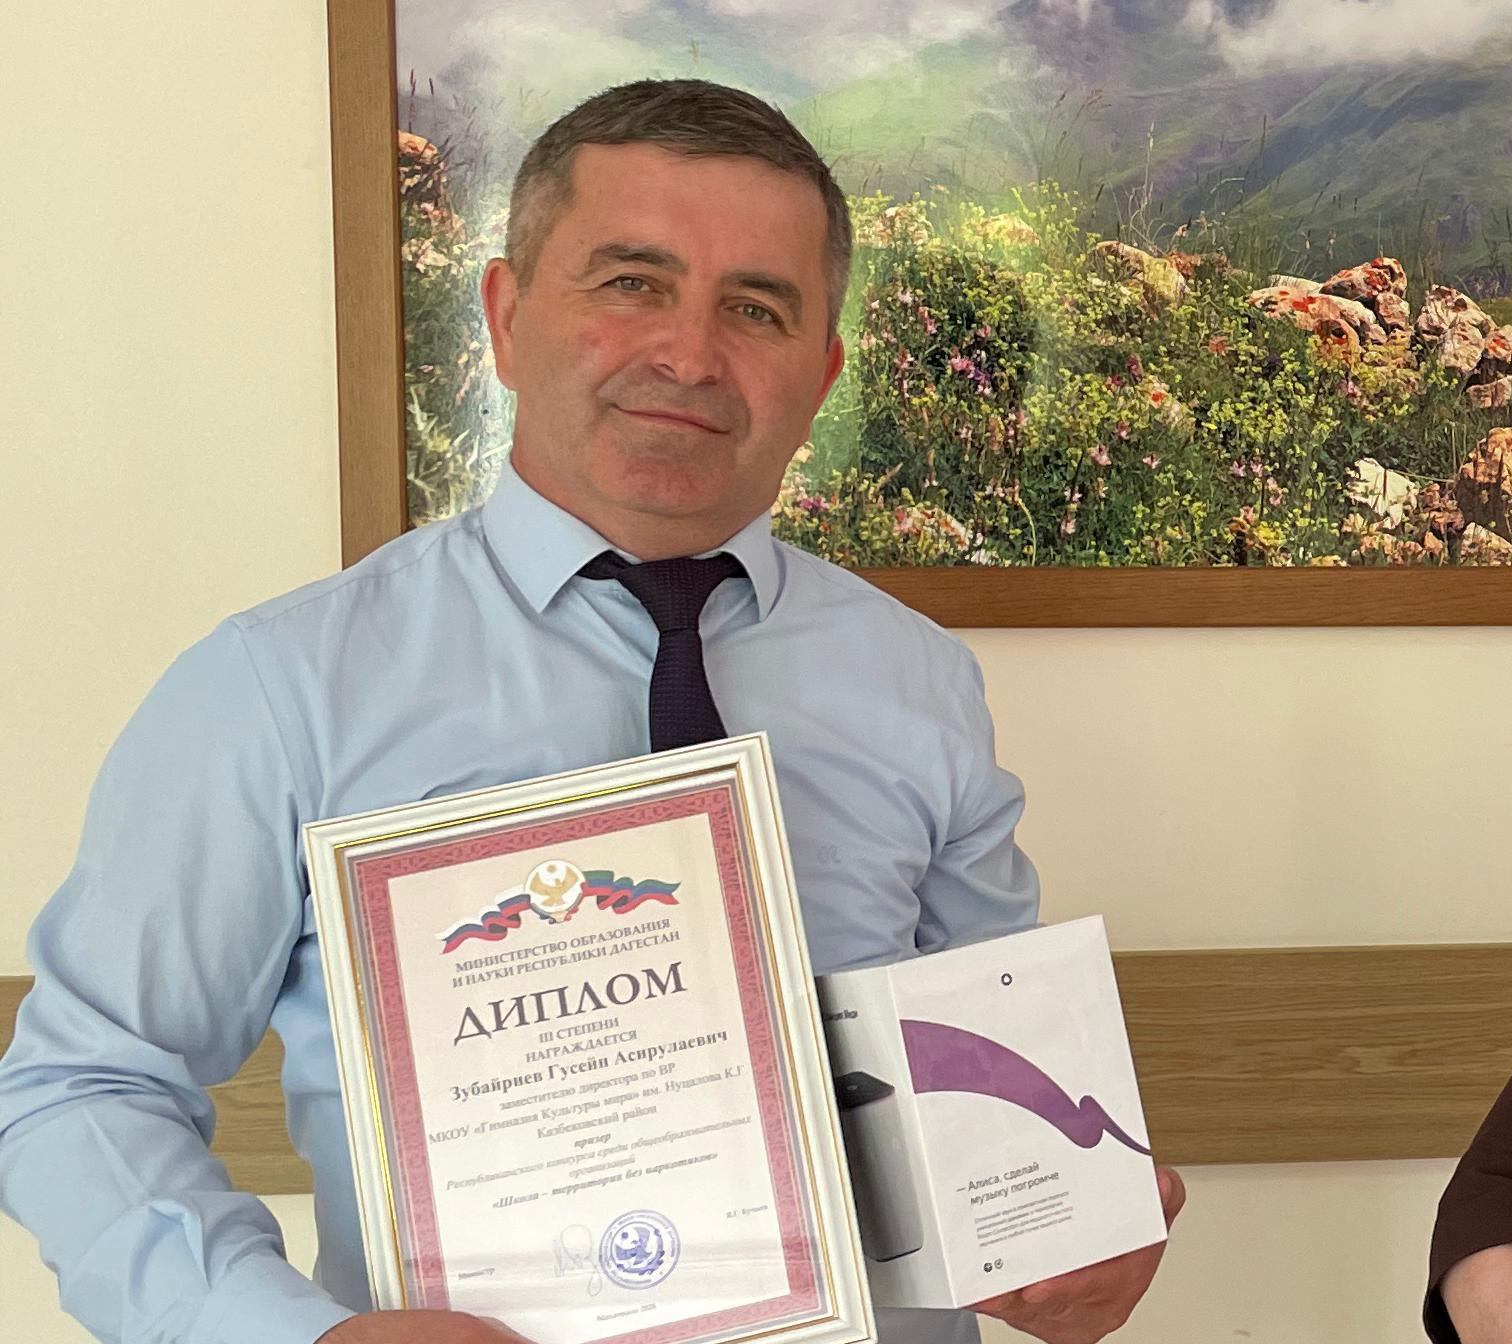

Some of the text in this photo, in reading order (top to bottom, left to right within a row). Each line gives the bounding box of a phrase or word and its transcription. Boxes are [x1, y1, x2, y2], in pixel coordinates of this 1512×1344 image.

[452, 930, 681, 989] И НАУКИ РЕСПУБЛИКИ ДАГЕСТАН
[455, 918, 671, 973] МИНИСТЕРСТВО ОБРАЗОВАНИЯ
[453, 961, 688, 1047] ДИПЛОМ
[525, 1029, 638, 1063] НАГРАЖДАЕТСЯ
[556, 1017, 620, 1040] СТЕПЕНИ
[450, 1070, 543, 1102] Зубайриев
[548, 1056, 609, 1082] Гусейн
[499, 1062, 676, 1111] заместителю директора по ВР
[428, 1125, 470, 1145] МКОУ
[541, 1099, 601, 1121] Культуры
[622, 1105, 657, 1123] район
[970, 1171, 1060, 1206] музыку погромче
[1003, 1161, 1041, 1181] сделай
